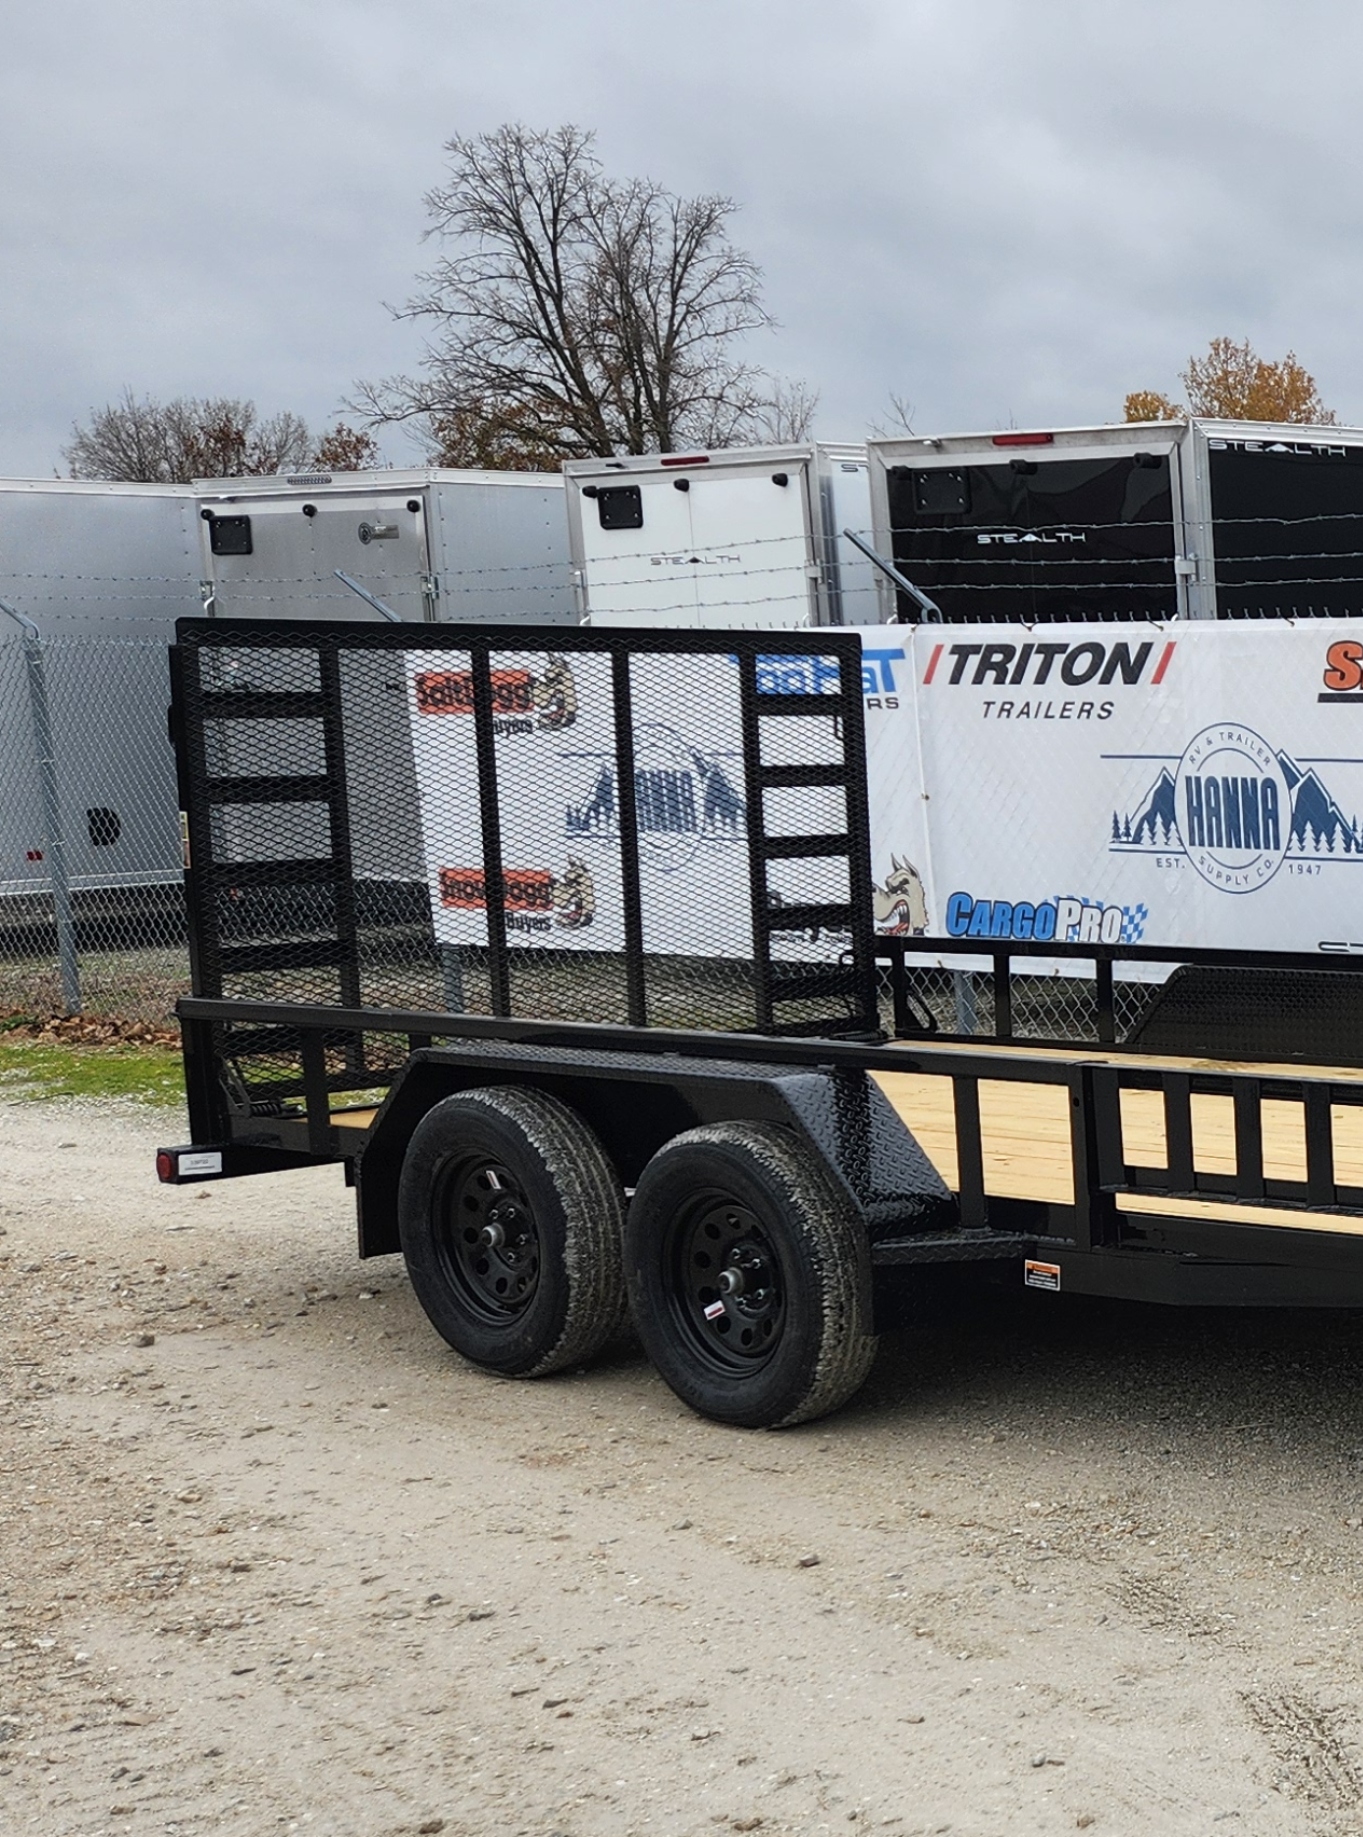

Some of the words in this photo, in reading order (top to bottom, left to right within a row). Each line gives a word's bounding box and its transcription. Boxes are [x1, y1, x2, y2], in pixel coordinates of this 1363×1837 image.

[1209, 439, 1347, 457] STEALTH
[977, 532, 1086, 544] STEALTH
[650, 555, 741, 566] STEALTH
[948, 641, 1155, 687] TRITON
[983, 700, 1115, 719] TRAILERS
[1188, 745, 1201, 765] RV
[1206, 736, 1214, 746] &
[1219, 731, 1271, 766] TRAILER
[1185, 775, 1281, 851] HANNA
[1156, 856, 1186, 870] EST.
[1199, 855, 1250, 886] SUPPLY
[1256, 859, 1275, 878] CO.
[1288, 863, 1322, 876] 1947
